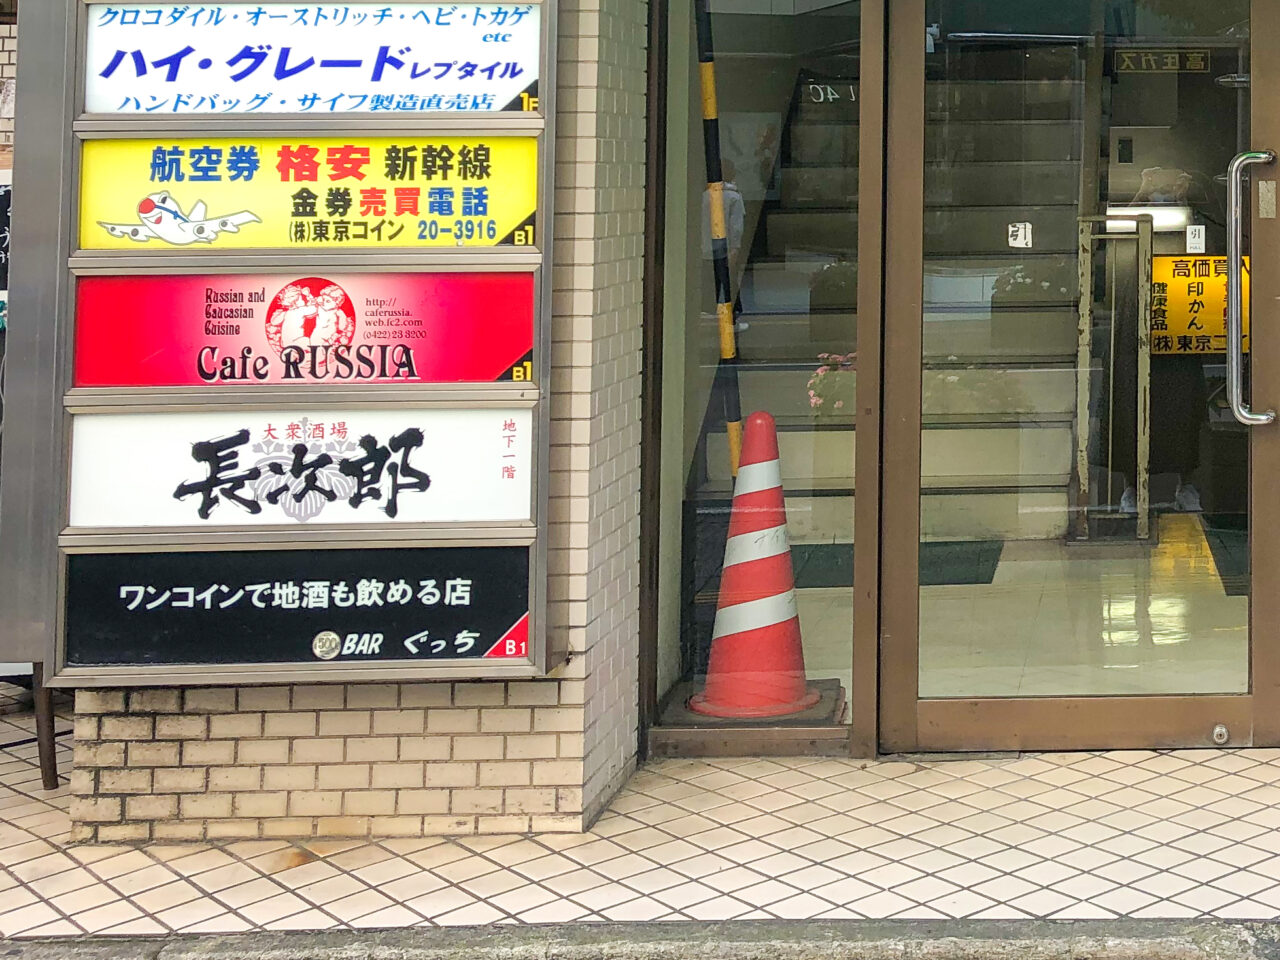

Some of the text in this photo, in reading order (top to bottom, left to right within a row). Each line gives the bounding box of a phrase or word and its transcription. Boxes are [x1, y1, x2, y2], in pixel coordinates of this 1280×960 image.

[482, 31, 513, 43] etc
[520, 92, 539, 112] 1F
[150, 144, 492, 182] 航空券 格安 新幹線
[417, 219, 497, 240] 20-3916
[513, 225, 534, 246] B1
[205, 287, 265, 303] Russian and
[364, 317, 423, 328] web.fc2.com
[197, 343, 419, 381] Cafe RUSSIA
[511, 361, 532, 382] B1
[263, 421, 349, 440] 大衆酒場
[501, 418, 517, 480] 地下一階
[173, 426, 431, 520] 長次郎
[119, 578, 472, 610] ワンコインで地酒も飲める店
[341, 633, 384, 656] BAR
[403, 629, 481, 654] ぐっち
[505, 639, 526, 655] B1
